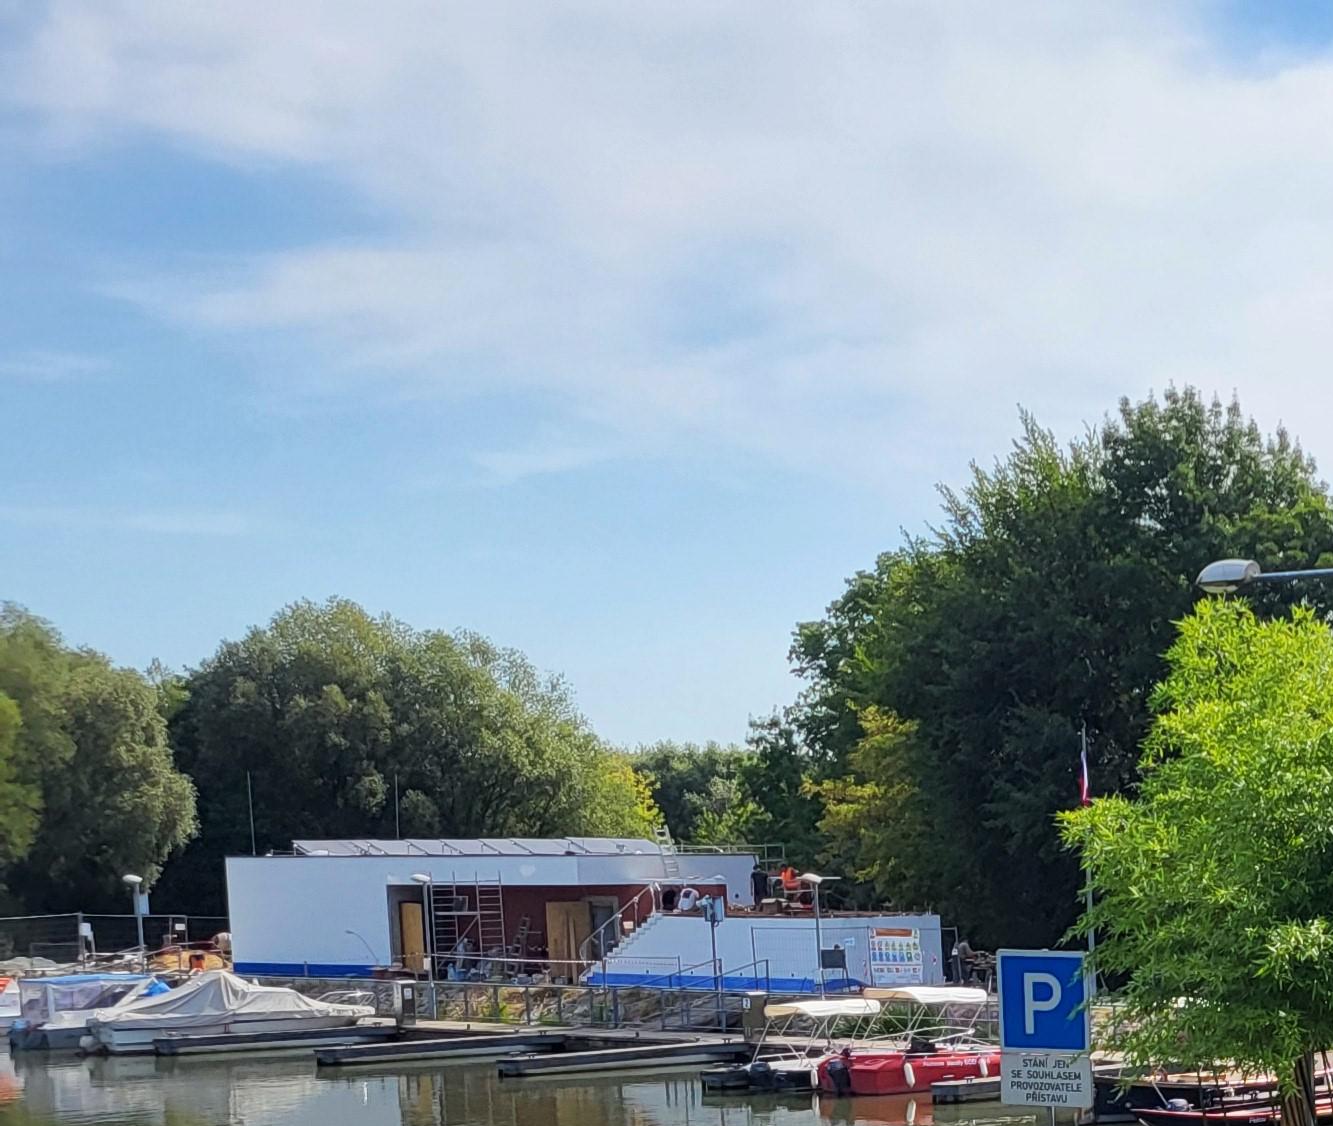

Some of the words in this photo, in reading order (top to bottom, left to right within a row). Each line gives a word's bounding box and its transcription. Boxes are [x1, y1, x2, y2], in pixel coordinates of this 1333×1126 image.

[1023, 972, 1062, 1035] P
[1022, 1056, 1048, 1069] STÁNÍ
[1052, 1059, 1070, 1069] JEN
[1011, 1069, 1023, 1079] SE
[1027, 1070, 1082, 1081] SOUHLASEM
[1010, 1080, 1083, 1093] PROVOZOVATELE
[1025, 1091, 1068, 1104] PŘÍSTAVU
